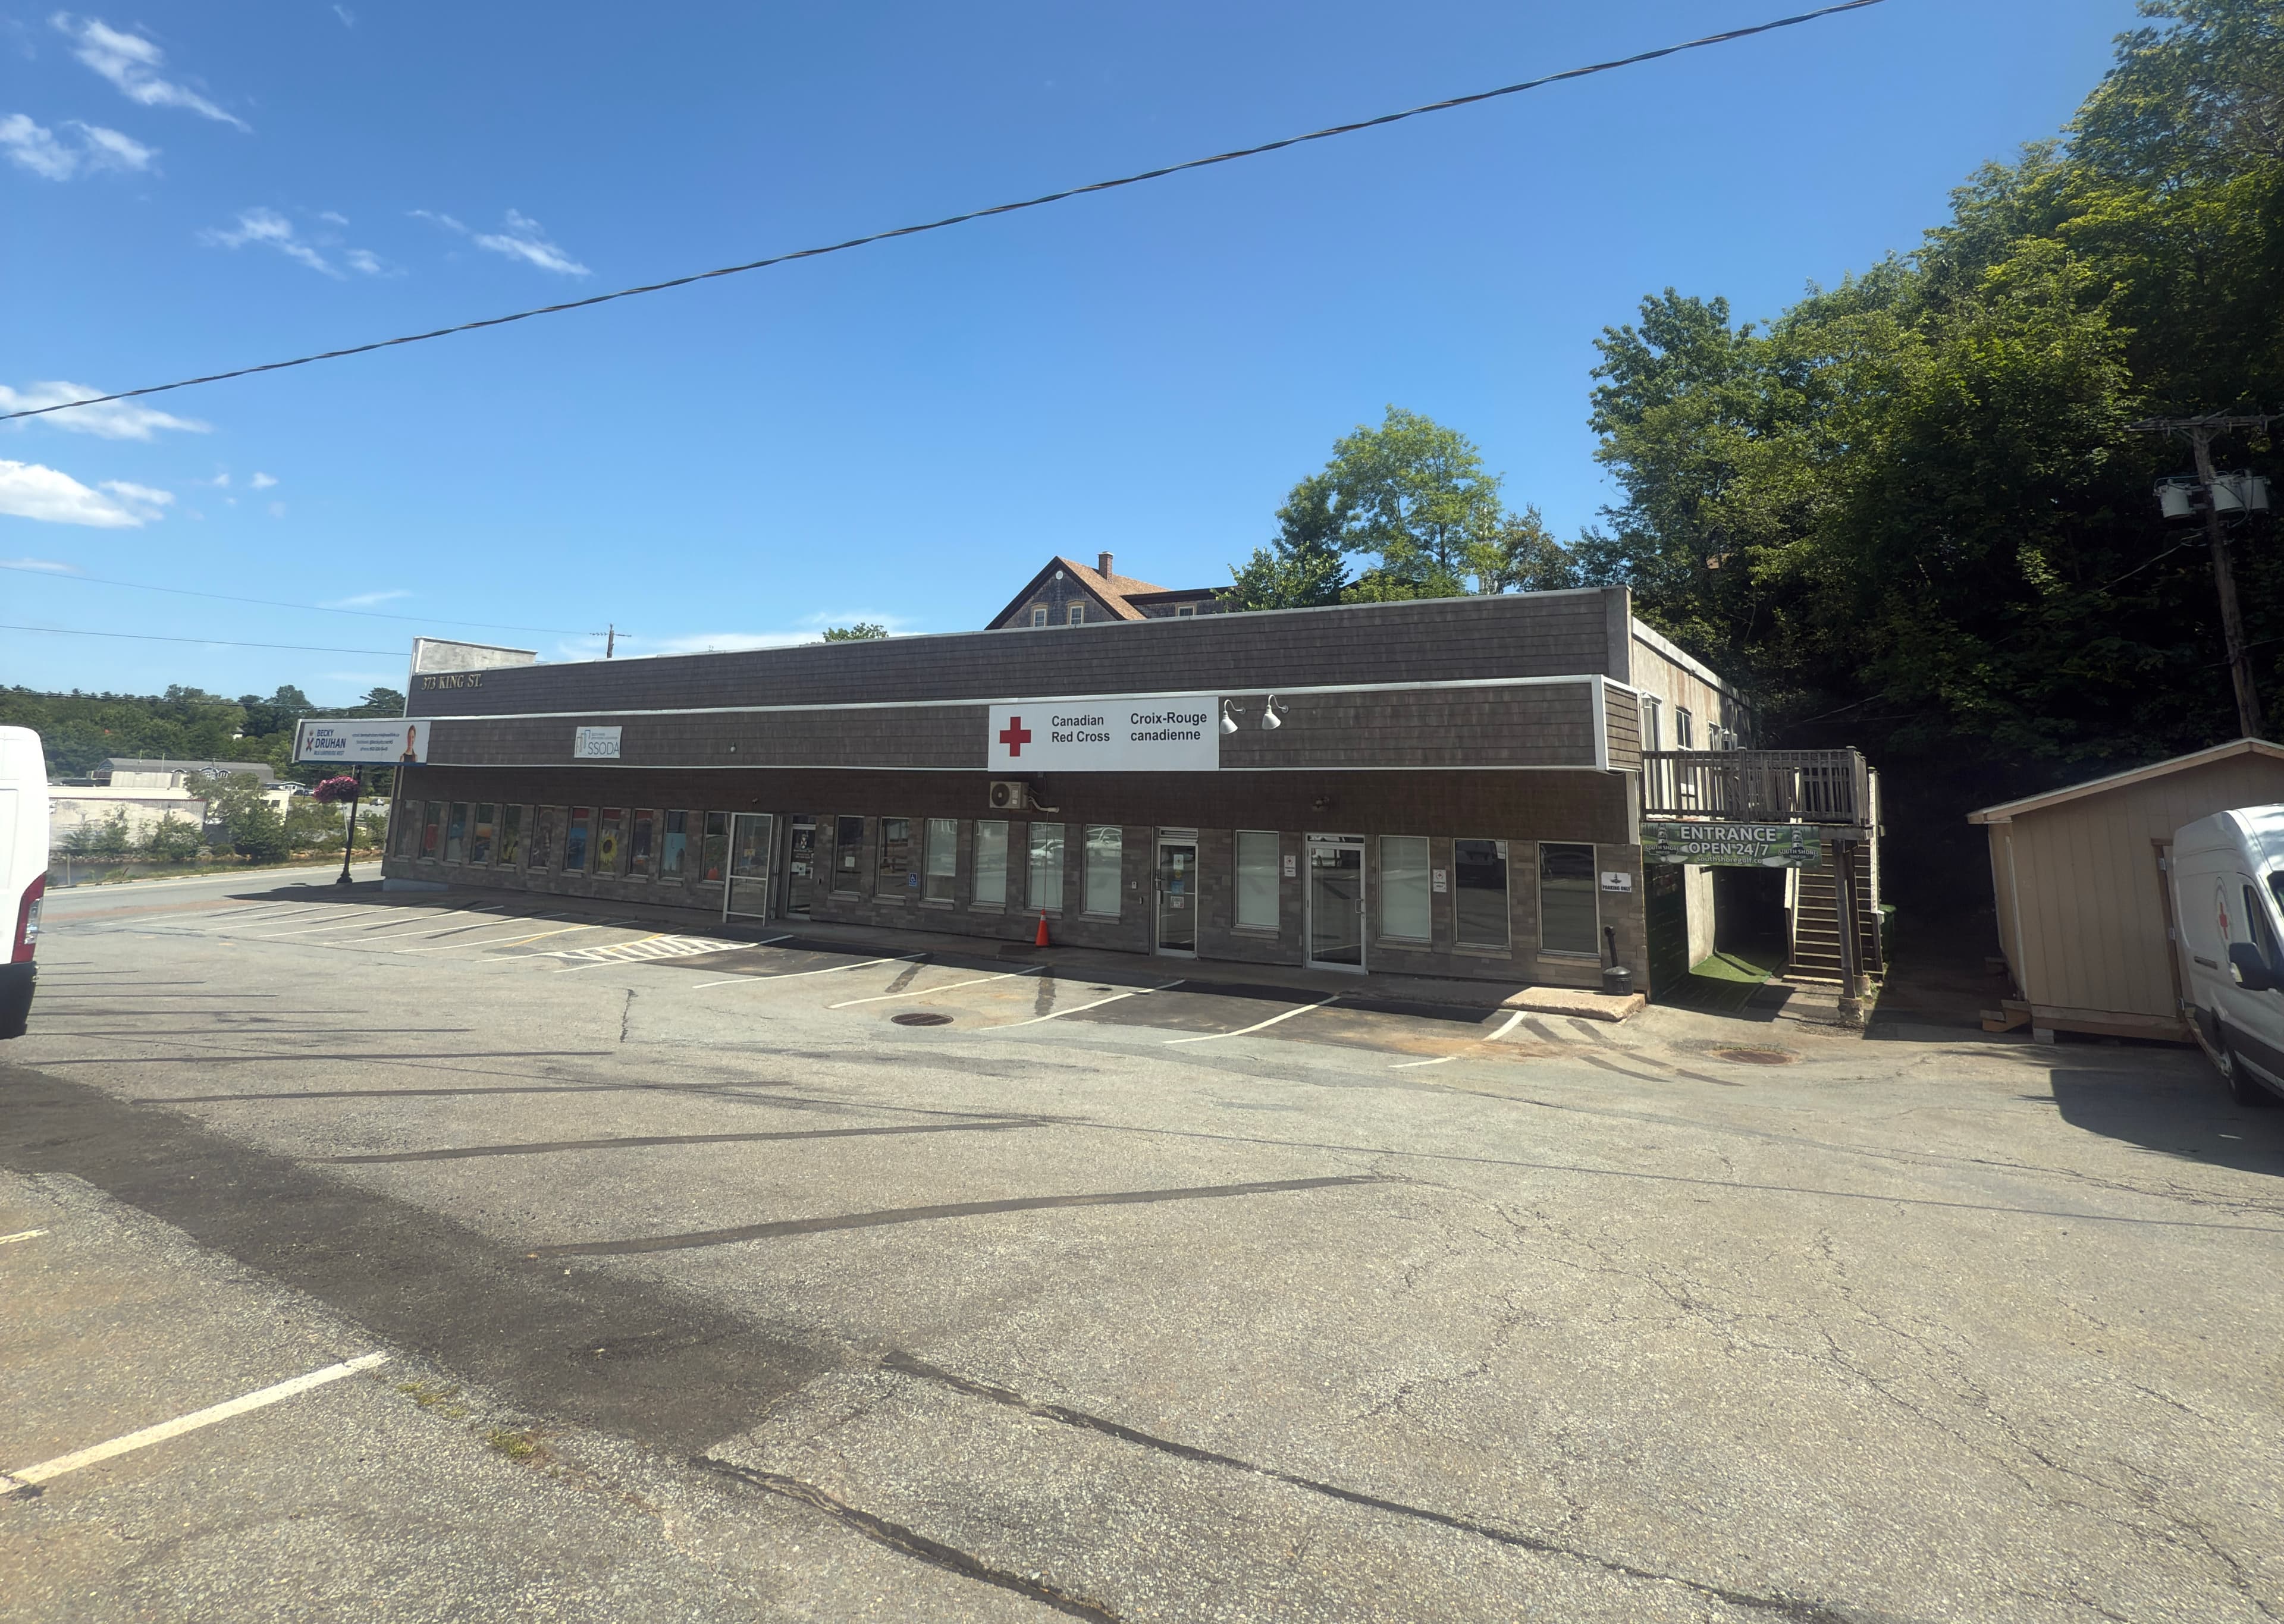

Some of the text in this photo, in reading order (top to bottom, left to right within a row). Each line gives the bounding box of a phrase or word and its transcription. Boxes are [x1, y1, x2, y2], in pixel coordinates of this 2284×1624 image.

[421, 674, 482, 690] 373 KING ST.
[1052, 714, 1104, 727] Canadian
[1131, 712, 1207, 725] Croix-Rouge
[1052, 731, 1110, 743] Red Cross
[1131, 729, 1201, 742] canadienne
[315, 737, 347, 748] DRUHAN
[588, 742, 619, 755] SSODA
[1680, 827, 1777, 841] ENTRANCE
[1689, 842, 1769, 857] OPEN 24/7
